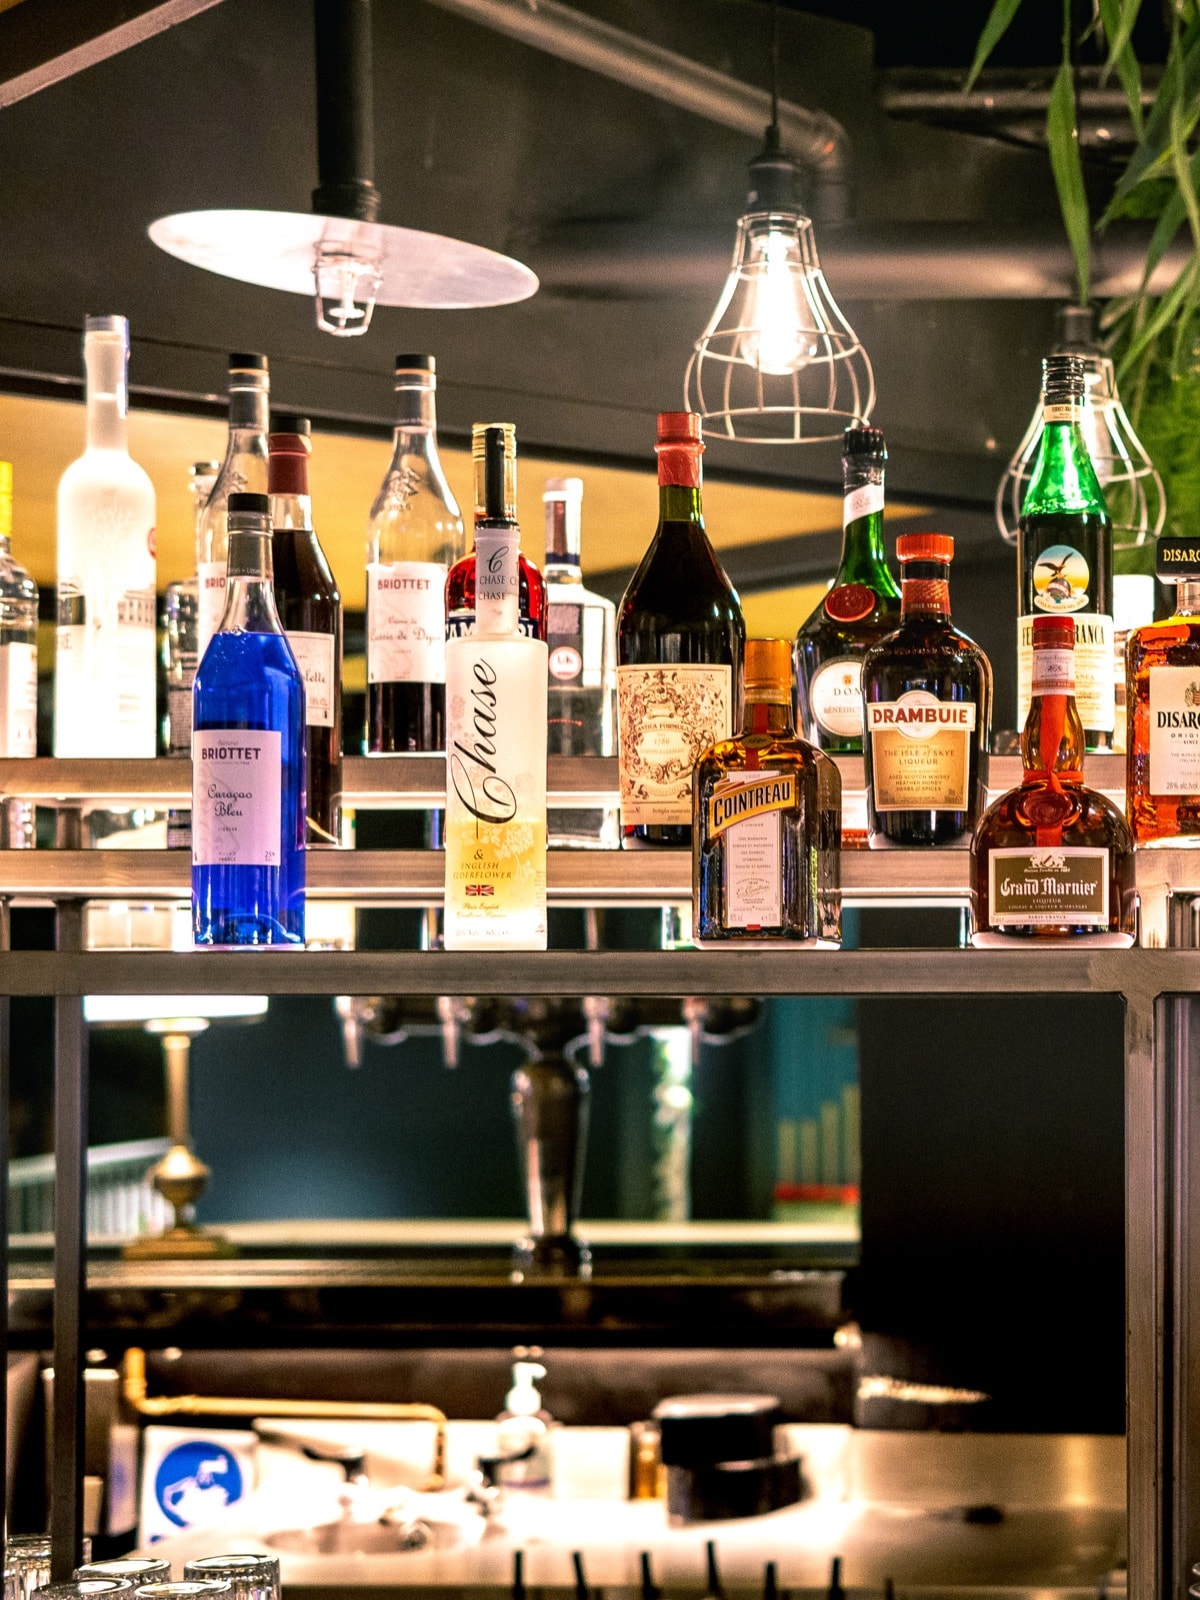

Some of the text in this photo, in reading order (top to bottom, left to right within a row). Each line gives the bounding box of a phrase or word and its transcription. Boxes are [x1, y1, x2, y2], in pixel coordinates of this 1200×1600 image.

[378, 578, 431, 590] BRIOTTET
[480, 575, 506, 586] CHASE
[478, 592, 506, 601] CHASE
[872, 708, 968, 724] DRAMBUIE
[638, 722, 690, 731] ANTICA FORMULA
[202, 748, 262, 760] BRIOTTET
[450, 658, 517, 840] Chase
[208, 784, 253, 803] Curaçao
[214, 802, 243, 817] Bleu
[714, 781, 790, 828] COINTREAU
[474, 848, 484, 860] &
[1000, 877, 1097, 897] Grand Marnier
